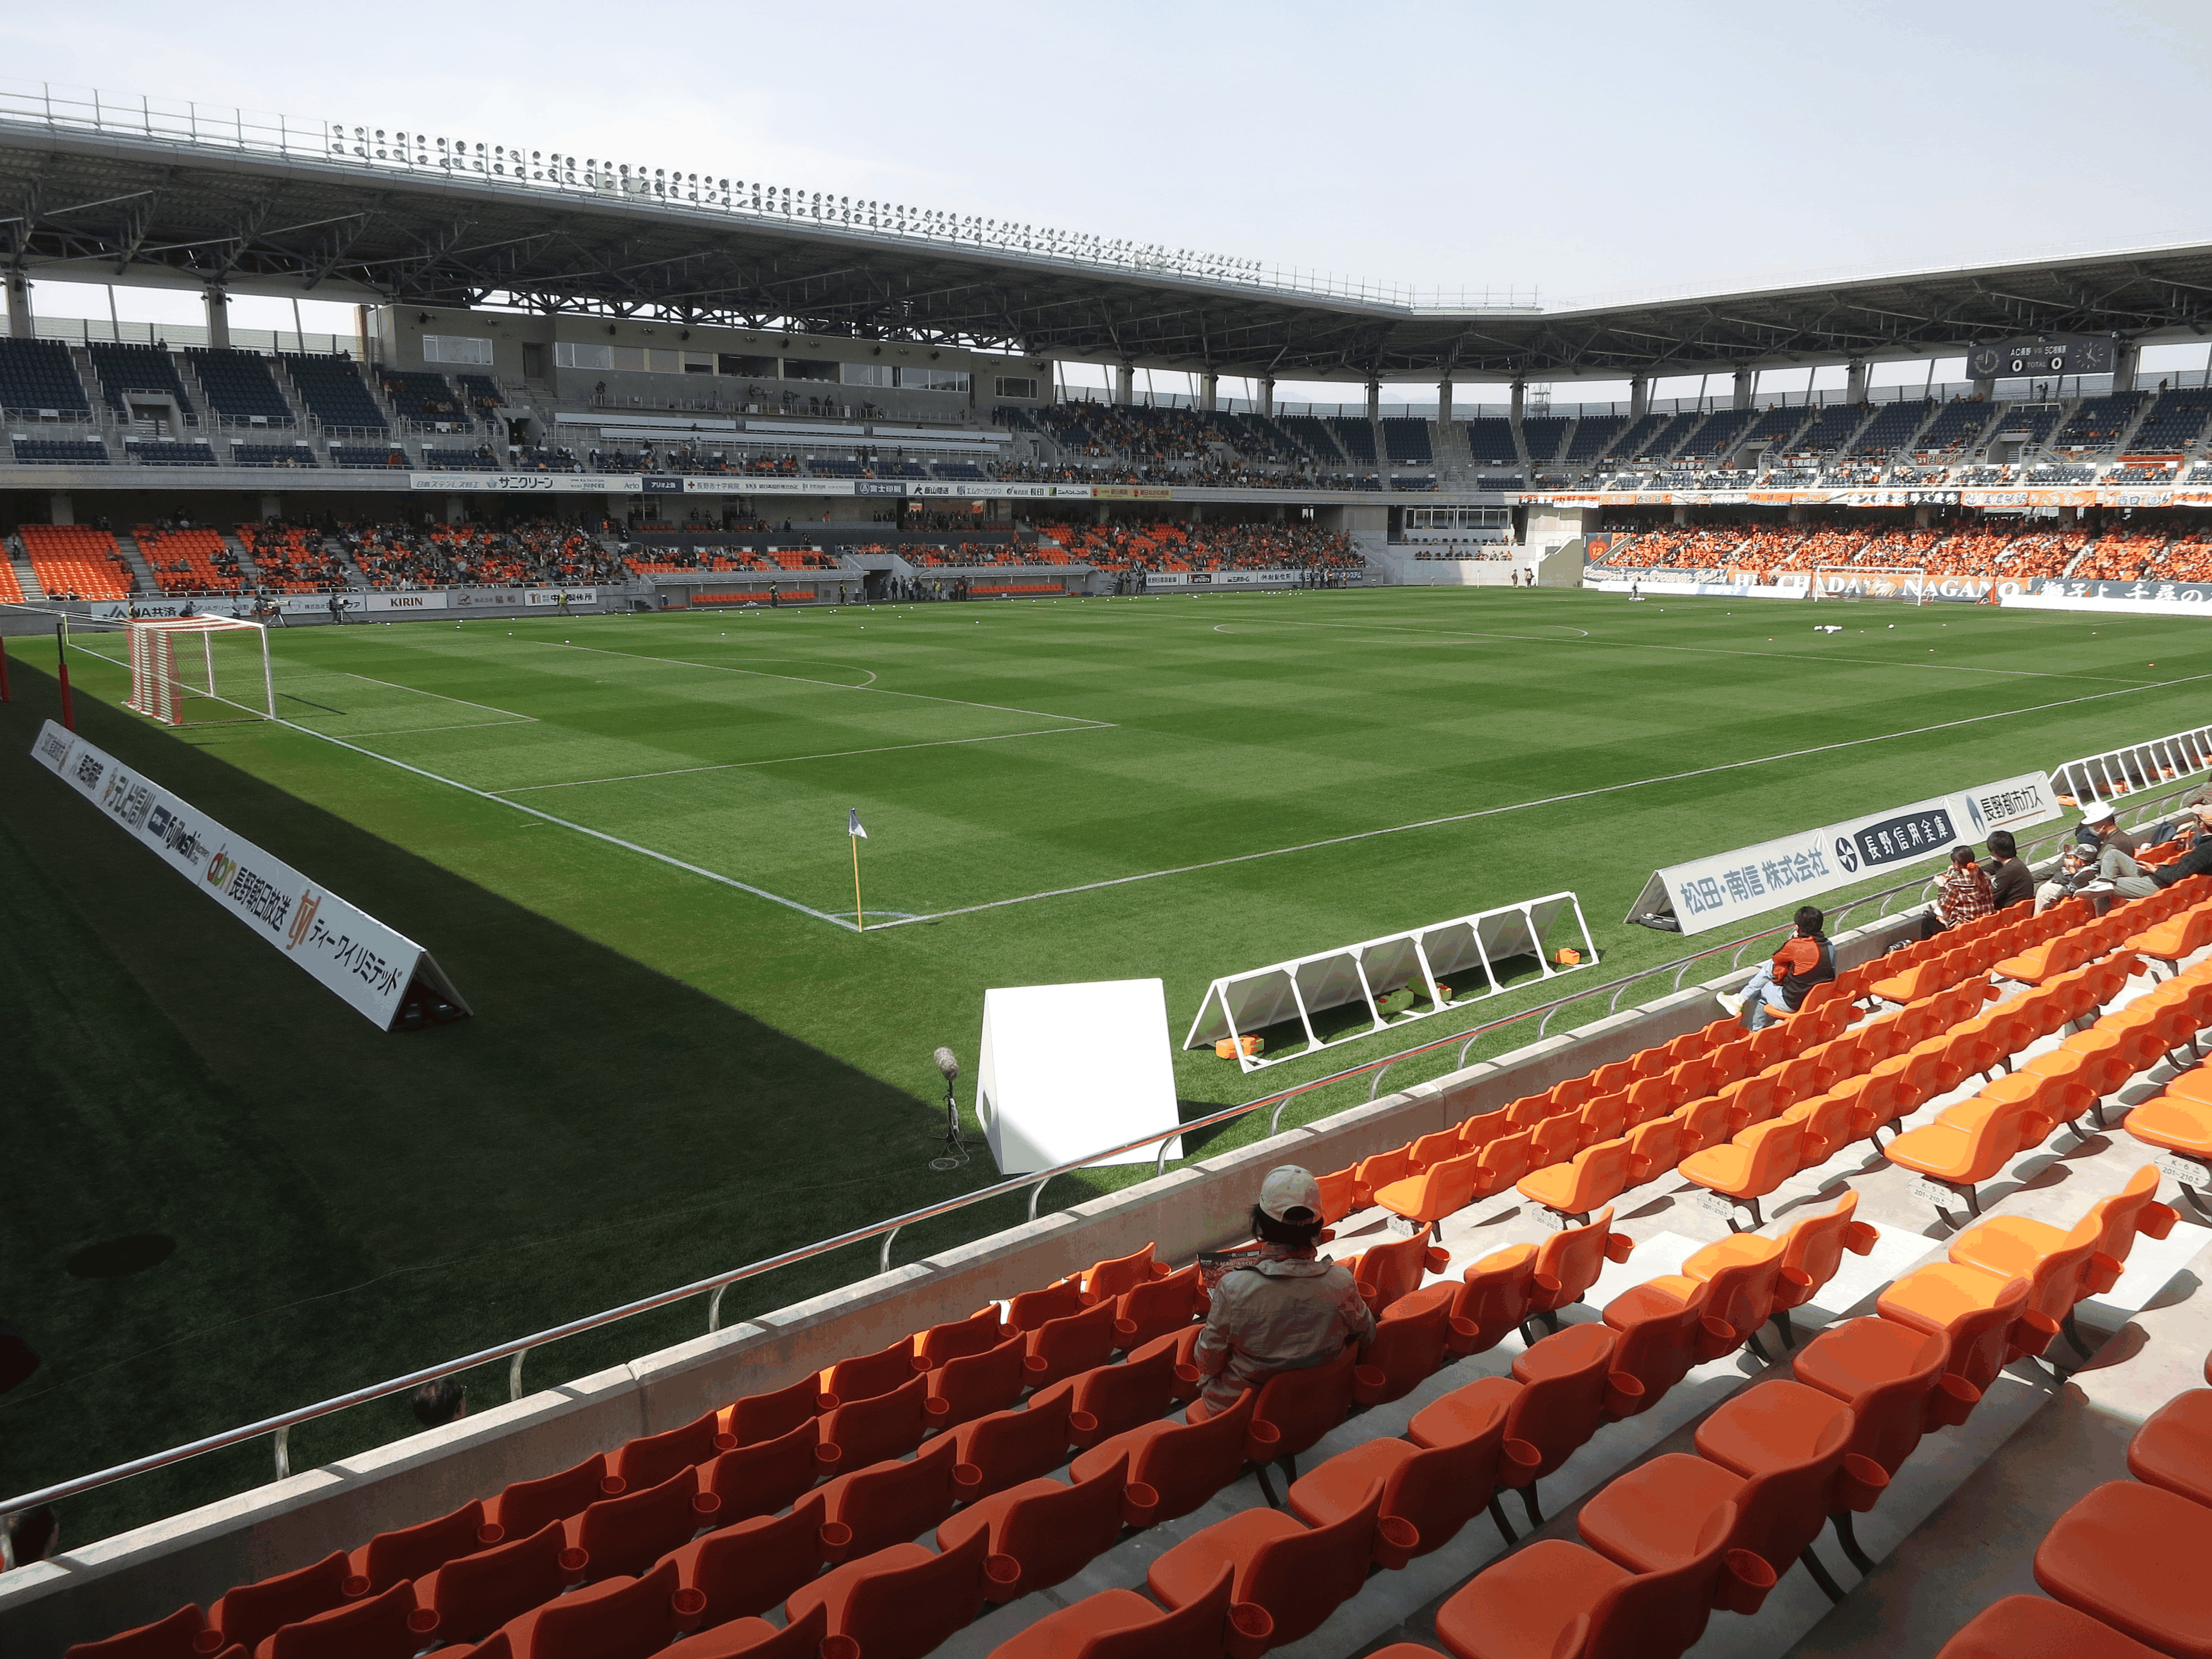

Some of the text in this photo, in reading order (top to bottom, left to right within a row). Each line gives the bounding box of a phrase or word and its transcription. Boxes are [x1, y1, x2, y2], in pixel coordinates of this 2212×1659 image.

[2012, 359, 2023, 372] 0
[2051, 357, 2062, 370] 0
[499, 477, 553, 489] サニクリーン
[1592, 546, 1604, 556] 12
[390, 597, 422, 607] KIRIN
[551, 593, 592, 602] 中製作所
[108, 775, 156, 830] テレビ信州
[1980, 785, 2044, 821] 長野都市ガス
[1864, 815, 1949, 861] 長野信用金庫
[1680, 847, 1830, 915] 松田・南信 株式会社
[228, 867, 291, 932] 長野朝日放送
[2171, 1159, 2189, 1170] K-6
[1922, 1182, 1937, 1192] K-5
[1708, 1196, 1721, 1206] K-4
